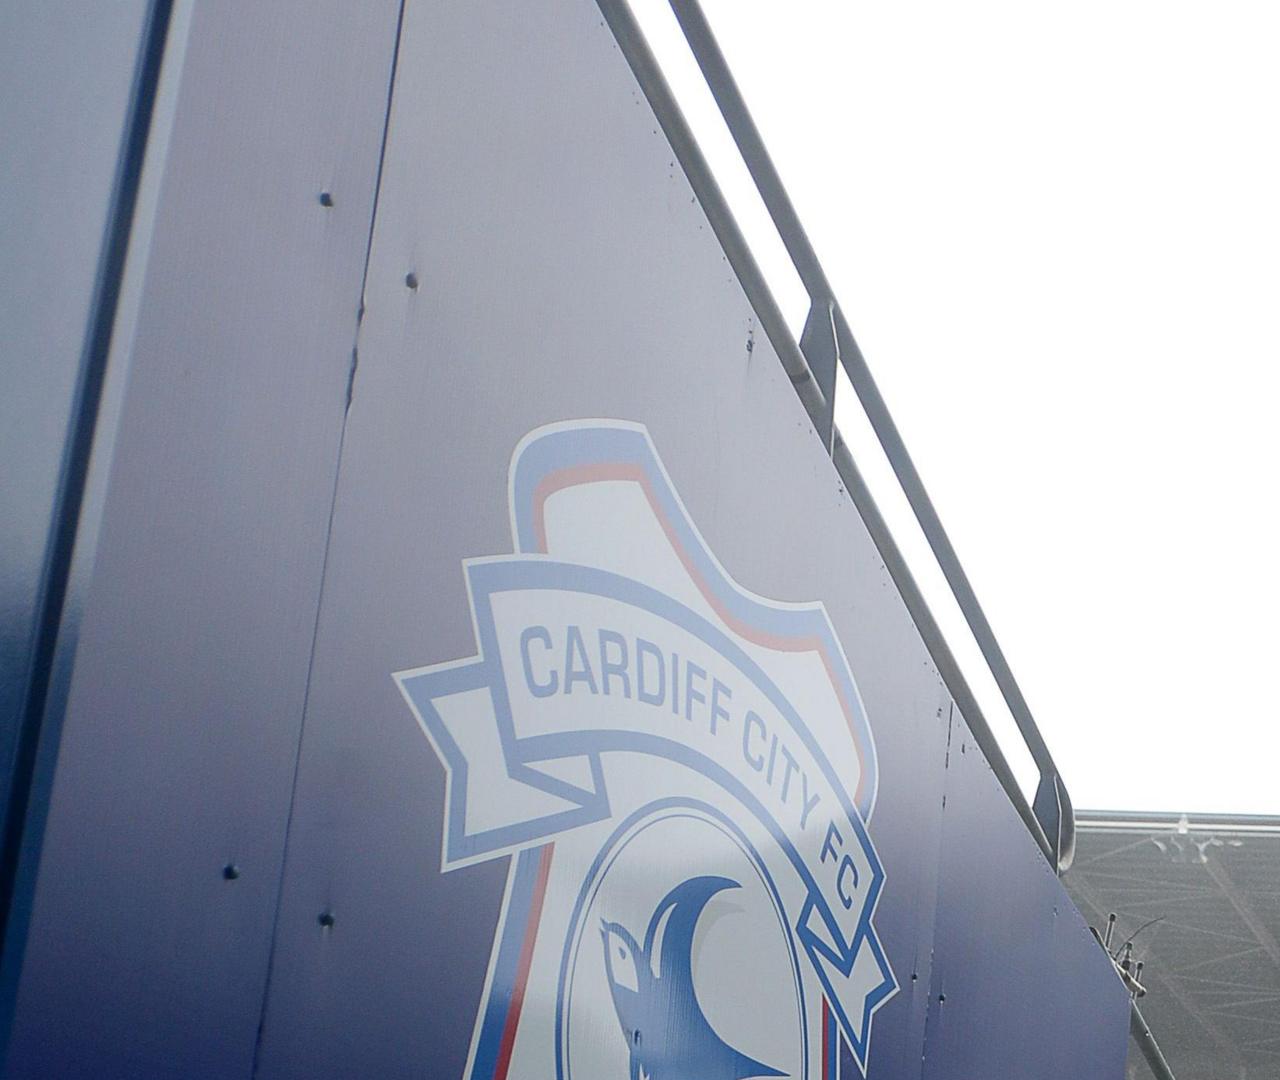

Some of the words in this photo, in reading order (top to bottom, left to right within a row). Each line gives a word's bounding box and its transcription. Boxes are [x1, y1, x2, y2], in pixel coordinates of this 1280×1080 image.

[518, 624, 732, 736] CARDIFF
[741, 709, 821, 831] CITY
[819, 820, 859, 909] FC
